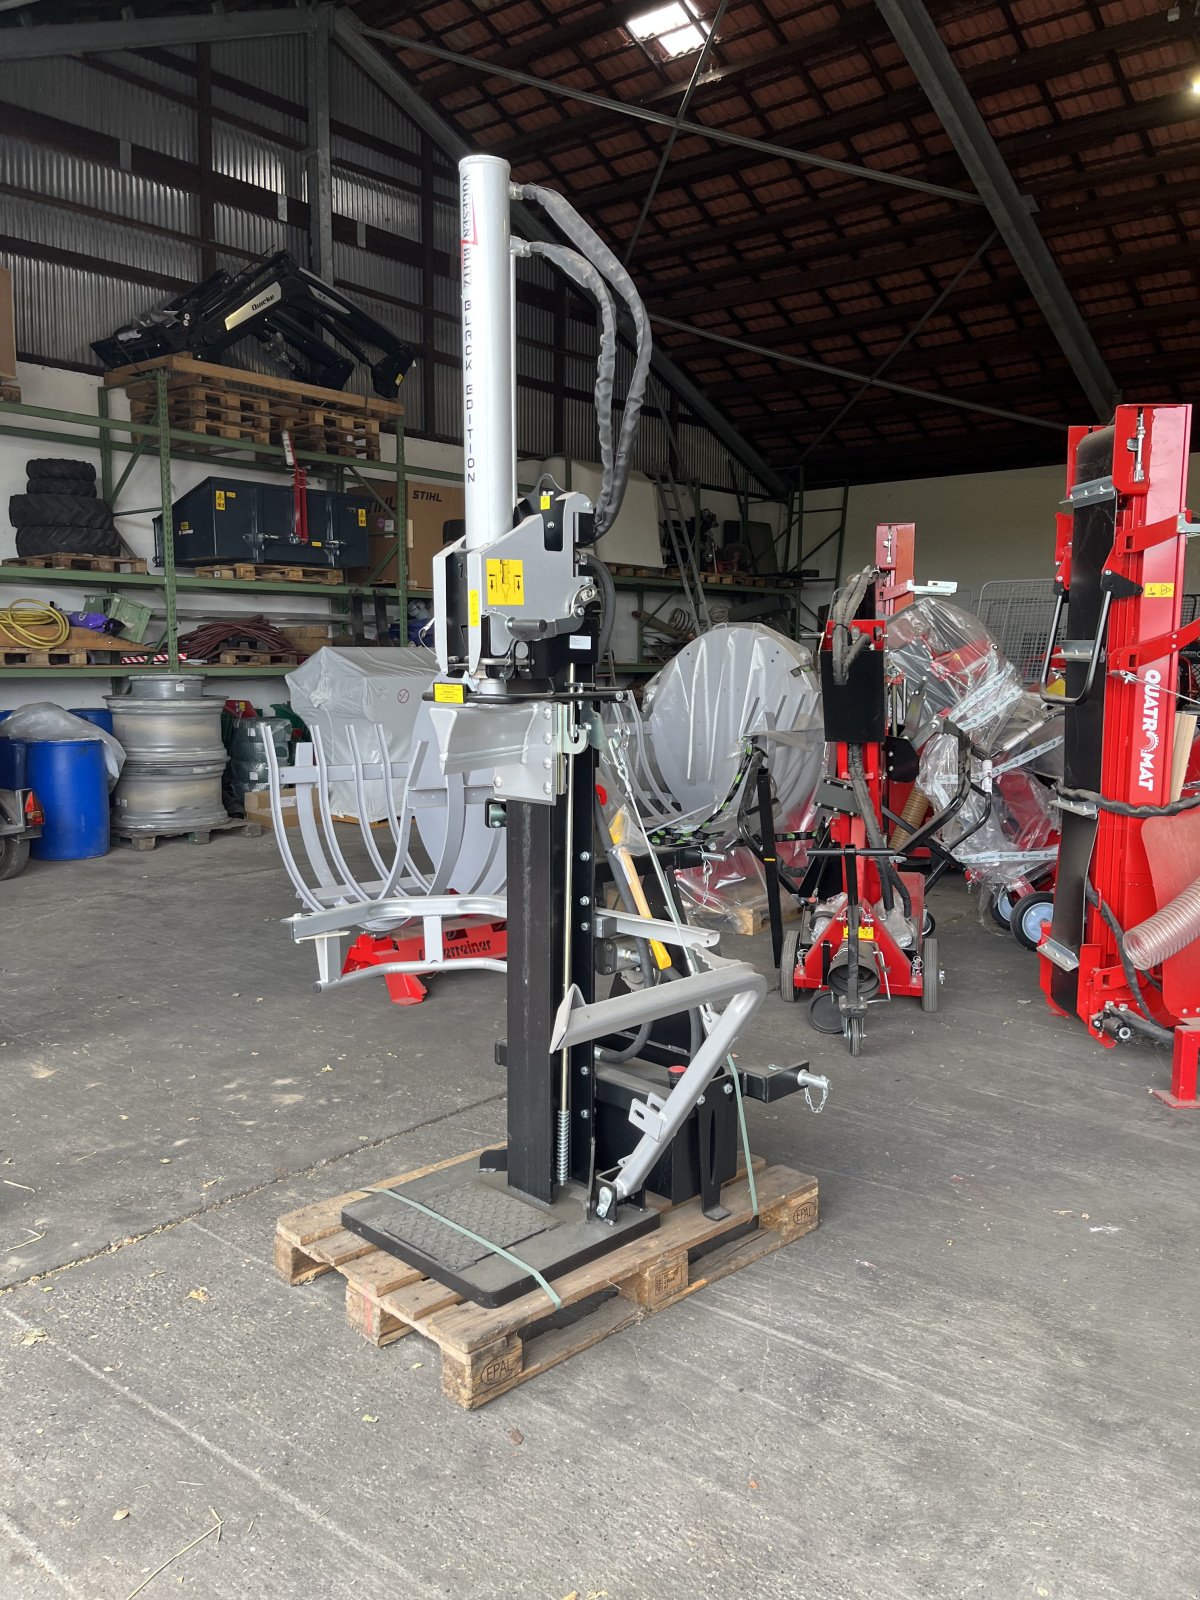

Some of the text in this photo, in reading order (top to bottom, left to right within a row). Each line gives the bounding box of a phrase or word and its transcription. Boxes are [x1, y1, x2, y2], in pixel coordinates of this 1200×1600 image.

[462, 173, 472, 288] VOGESEN BLITZ
[251, 294, 275, 311] Quicke
[464, 300, 476, 484] BLACK EDITION
[412, 490, 442, 502] STIHL
[796, 1205, 815, 1221] EPAL
[486, 1359, 514, 1381] EPAL
